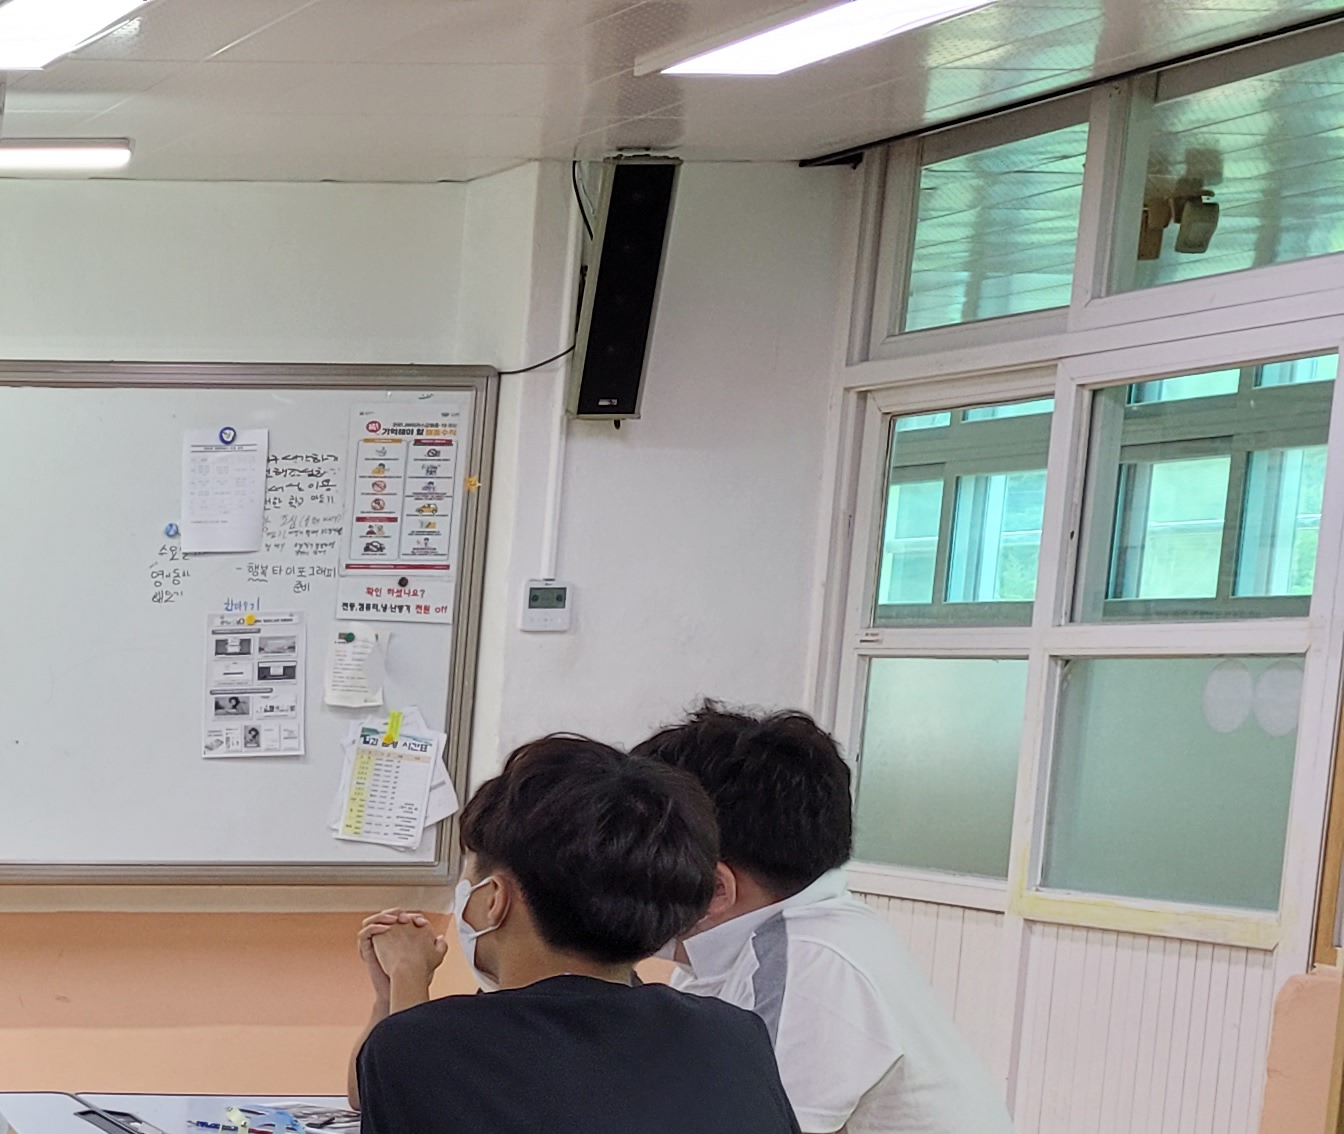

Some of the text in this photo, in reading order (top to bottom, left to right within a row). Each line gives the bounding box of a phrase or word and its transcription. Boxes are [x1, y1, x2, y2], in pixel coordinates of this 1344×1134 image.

[365, 587, 425, 599] 확인 하셨나요?
[415, 604, 430, 614] 전원
[434, 605, 448, 614] off
[402, 742, 428, 752] 시간표
